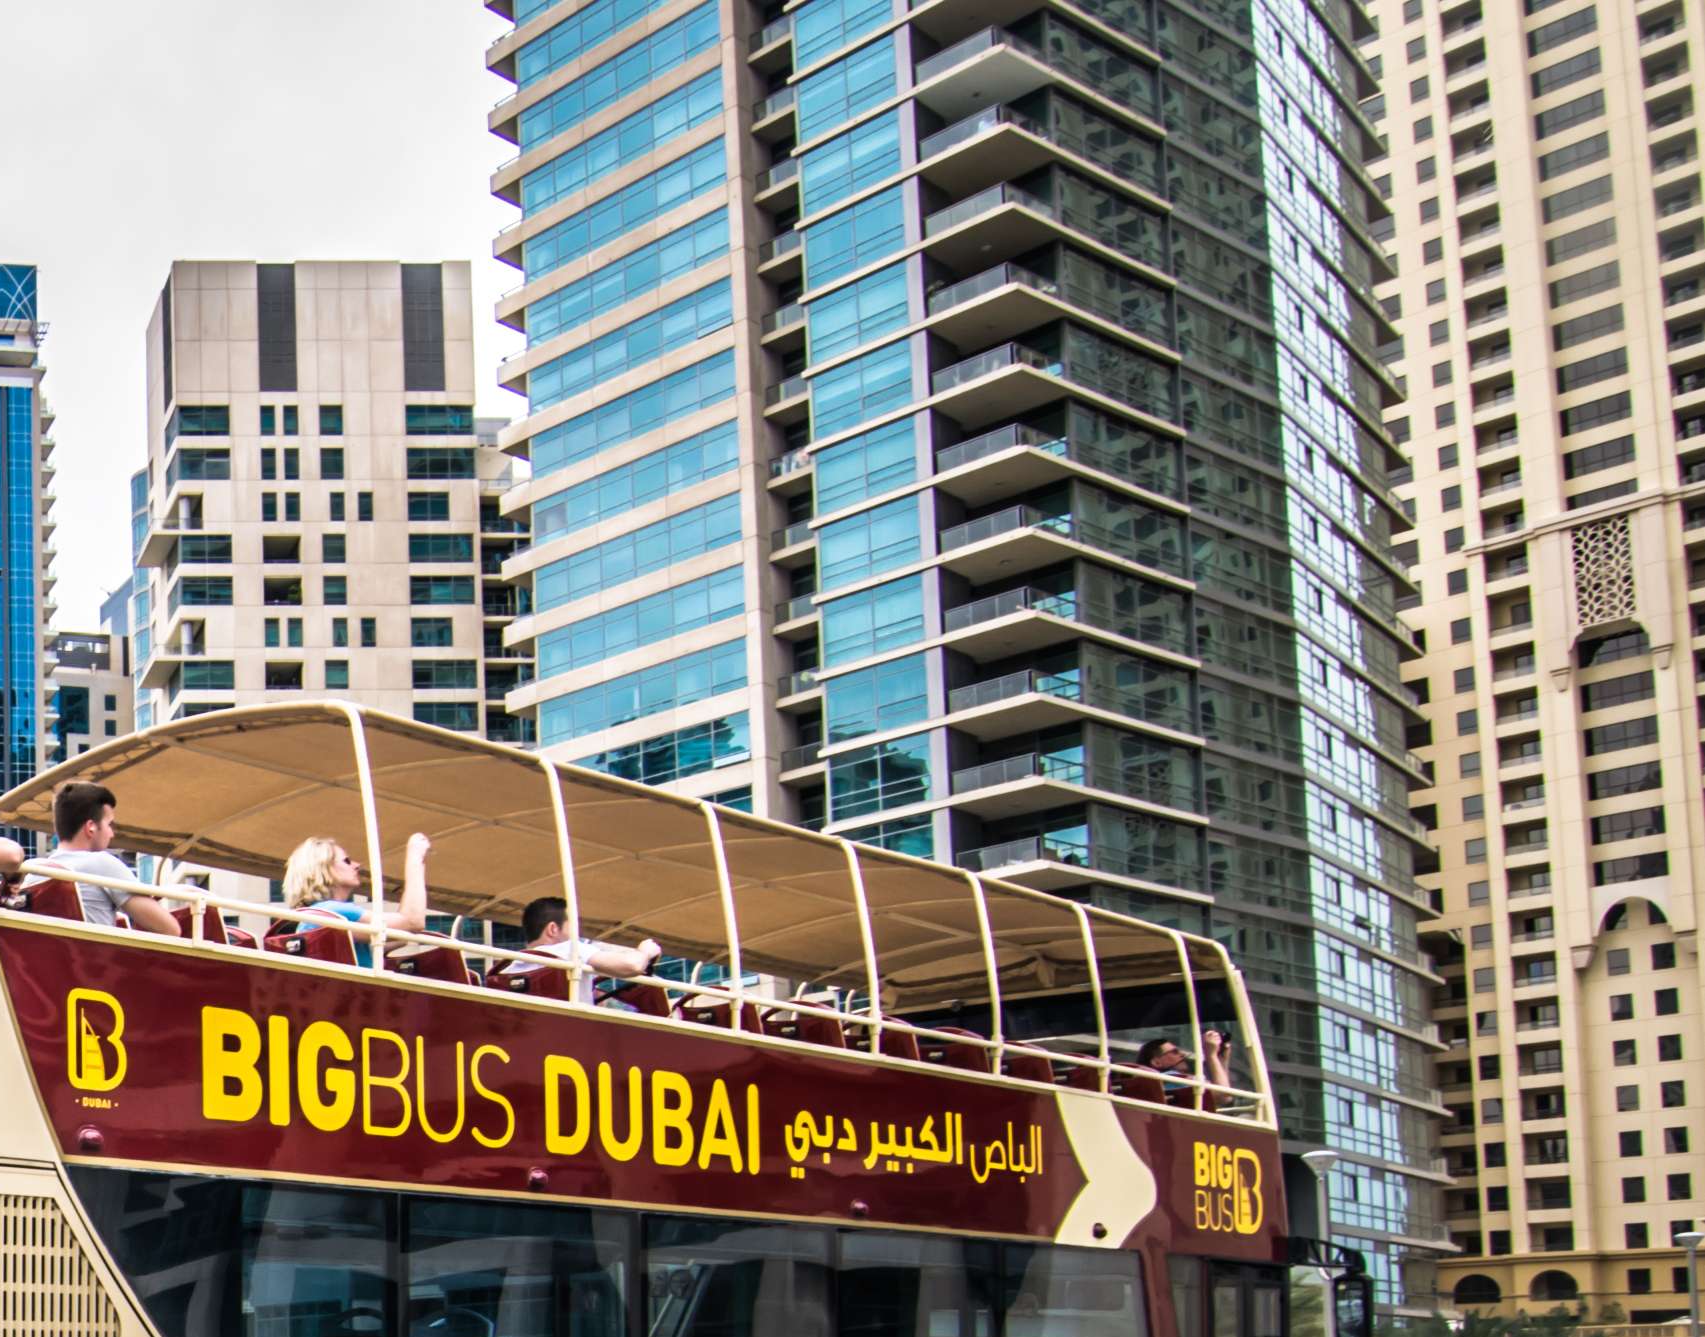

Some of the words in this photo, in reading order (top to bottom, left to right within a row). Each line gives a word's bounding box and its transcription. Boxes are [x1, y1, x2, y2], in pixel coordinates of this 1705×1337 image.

[544, 1054, 760, 1175] DUBAI
[784, 1110, 858, 1179] دبي
[863, 1111, 963, 1174] الكبير
[970, 1121, 1043, 1184] الباص
[1194, 1141, 1233, 1190] BIG
[1195, 1189, 1234, 1233] BUS
